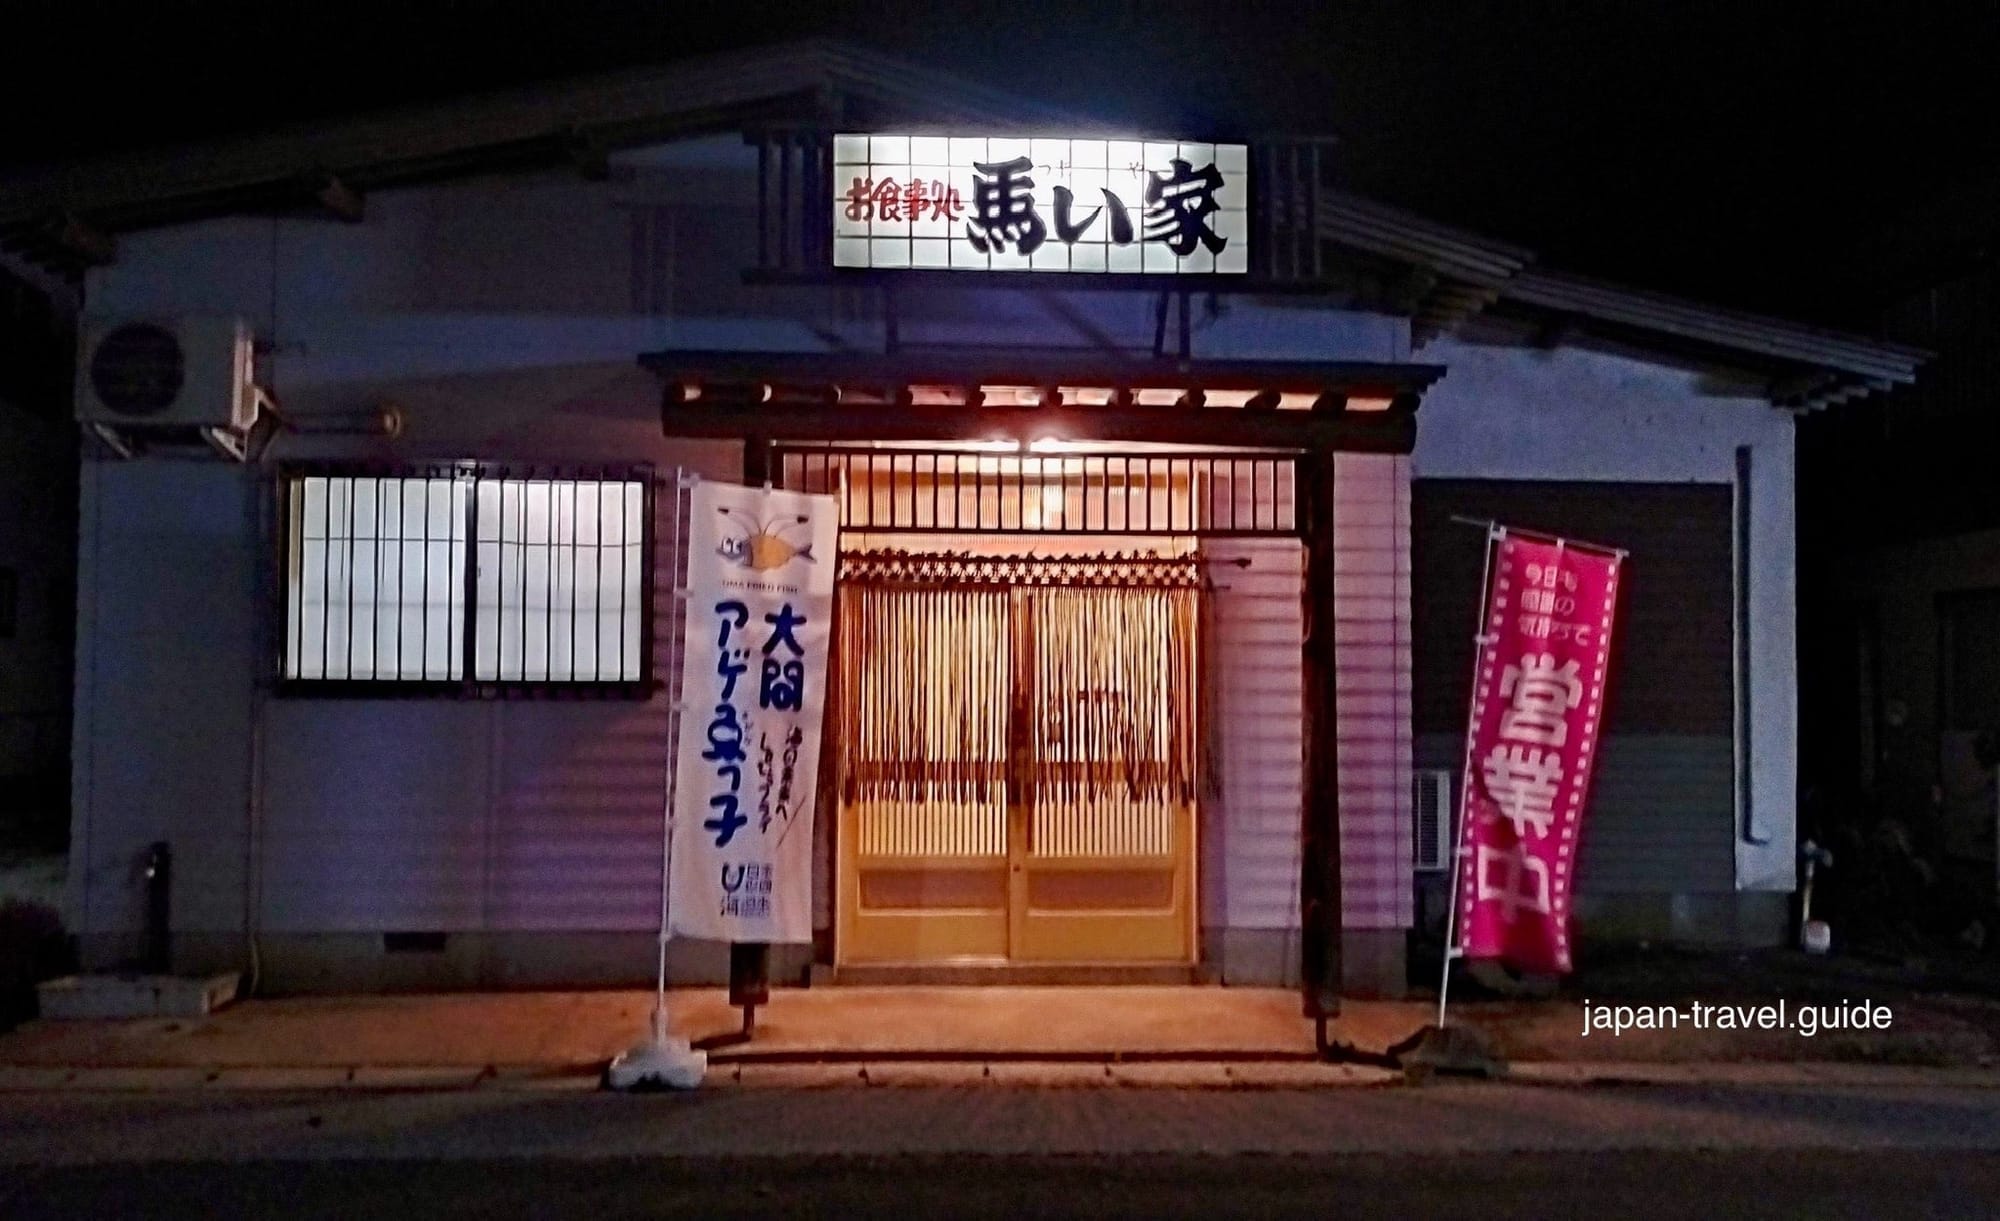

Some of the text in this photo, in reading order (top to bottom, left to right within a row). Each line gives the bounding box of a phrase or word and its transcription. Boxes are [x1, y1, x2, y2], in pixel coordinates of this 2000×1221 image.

[844, 155, 1228, 256] お食事処 馬い家
[759, 603, 808, 713] 大間
[1477, 652, 1584, 923] 営業中
